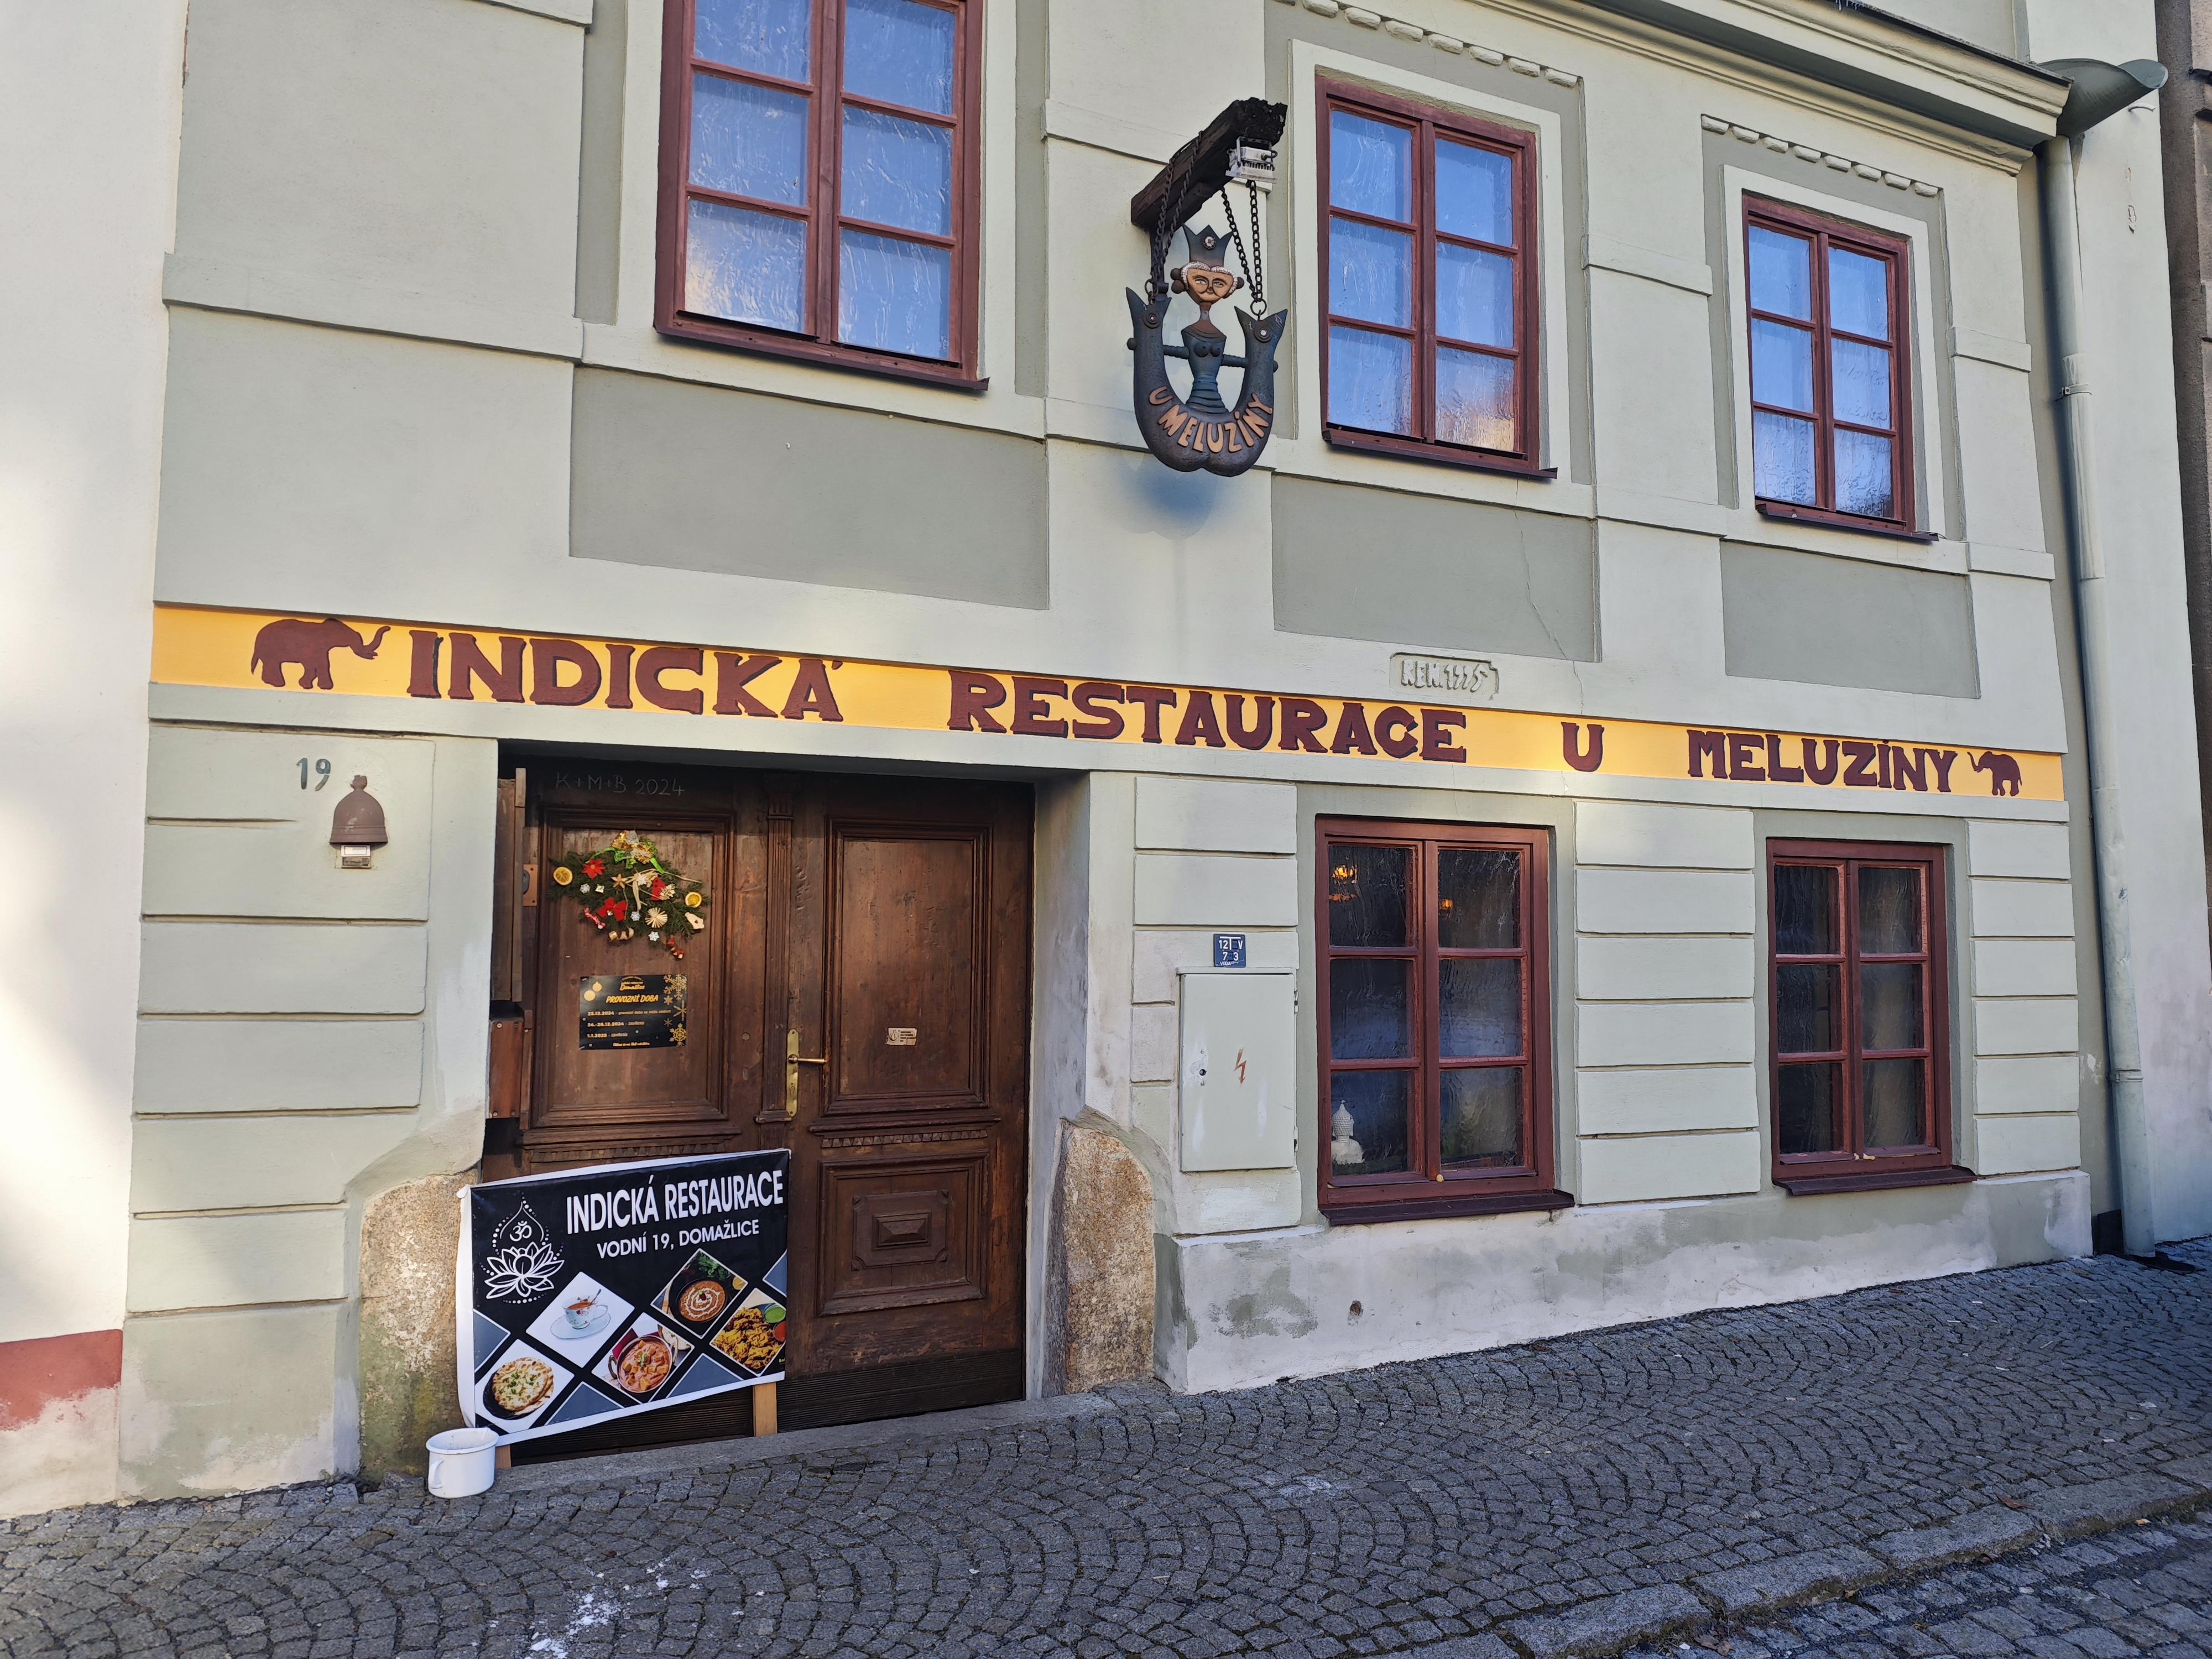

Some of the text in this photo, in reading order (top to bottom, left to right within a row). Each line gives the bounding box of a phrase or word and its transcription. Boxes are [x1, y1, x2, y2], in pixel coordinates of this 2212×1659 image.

[1149, 386, 1172, 405] U
[947, 670, 1467, 763] RESTAURACE
[1561, 722, 1604, 772] U
[296, 758, 331, 791] 19
[635, 778, 685, 796] 2024
[1219, 940, 1228, 949] 12
[606, 994, 659, 1003] PROVOZNÍ DOBA
[567, 1170, 784, 1234] INDICKÁ RESTAURACE
[597, 1219, 760, 1259] VODNÍ 19, DOMAŽLICE
